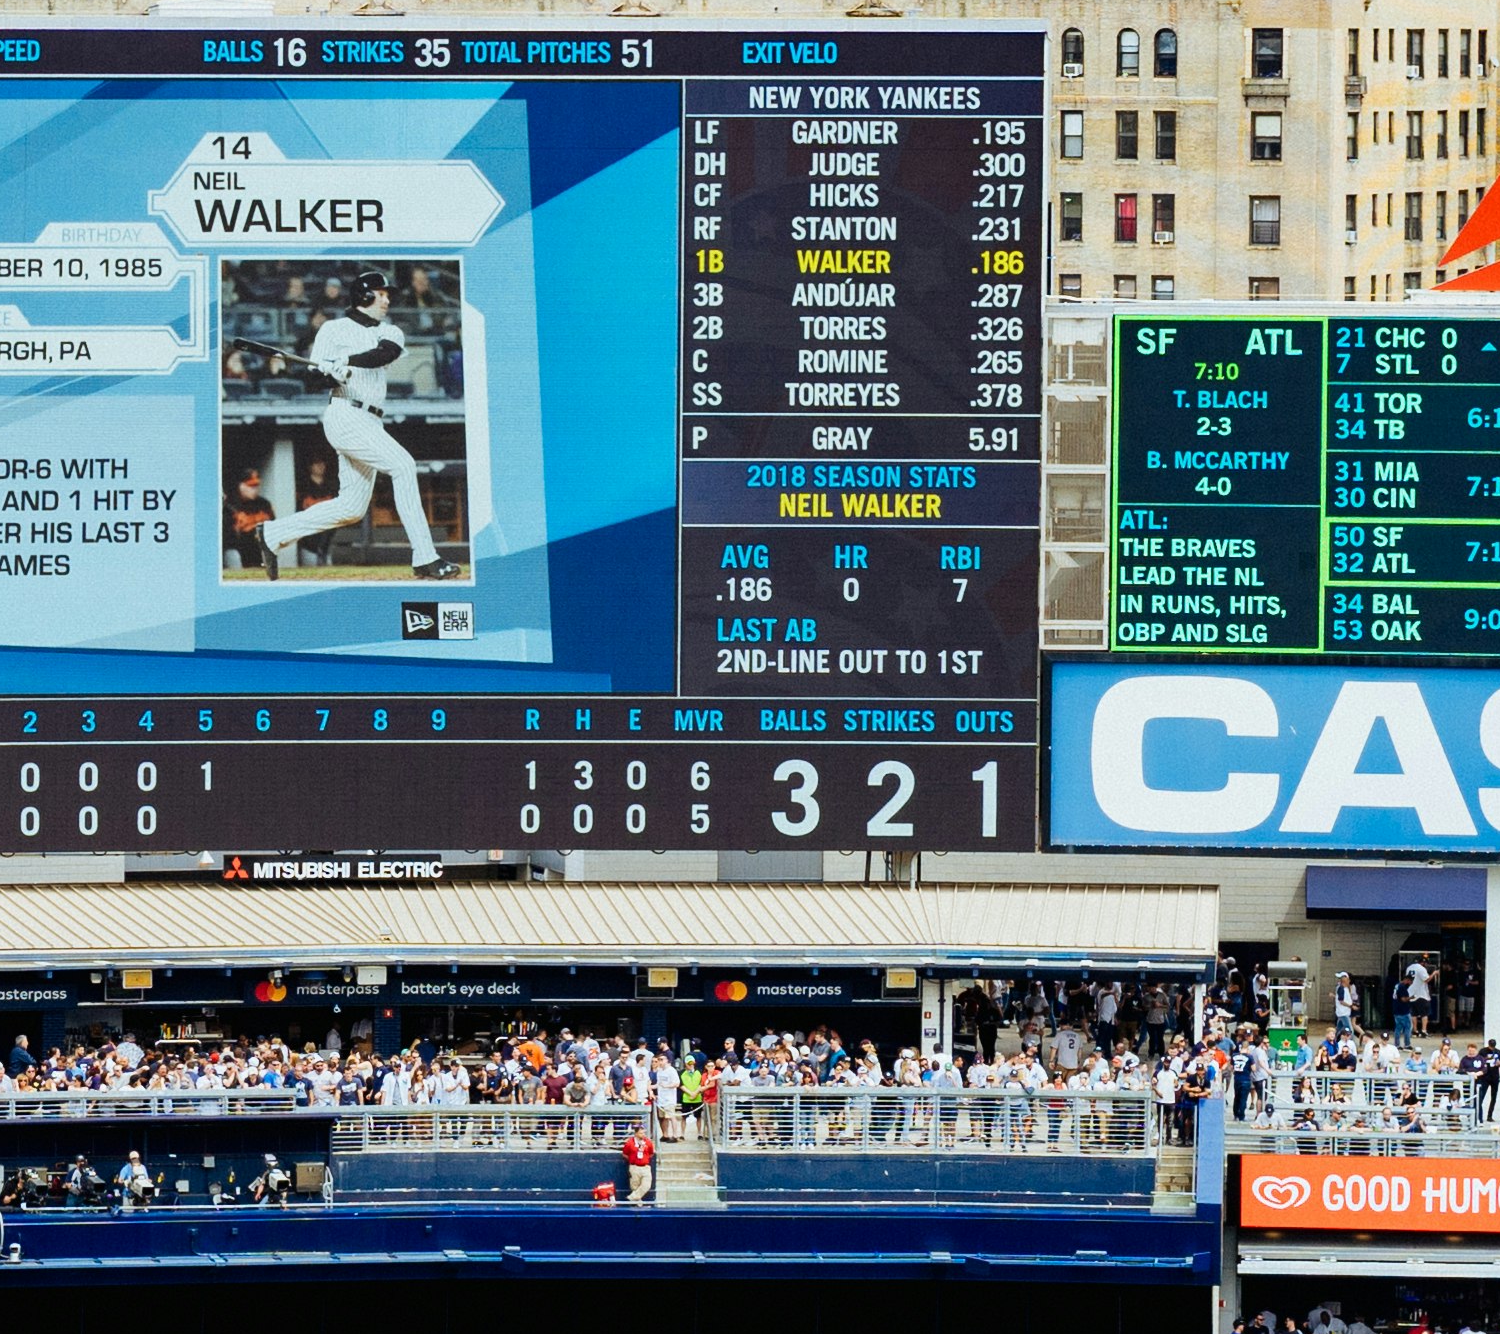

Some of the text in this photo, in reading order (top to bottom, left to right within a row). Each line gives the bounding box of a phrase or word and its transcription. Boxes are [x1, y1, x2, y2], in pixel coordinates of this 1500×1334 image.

[203, 38, 307, 66] BALLS 16
[749, 86, 981, 110] NEW YORK YANKEES
[695, 120, 1025, 145] LF GARDNER .195
[193, 172, 244, 191] NEIL
[194, 198, 385, 234] WALKER
[53, 257, 89, 281] 10,
[100, 258, 162, 278] 1985
[60, 342, 91, 361] PA
[1136, 329, 1302, 356] SF ATL
[253, 860, 443, 880] MITSUBISHI ELECTRIC
[401, 982, 520, 998] batter's eye deck
[756, 983, 842, 998] masterpass
